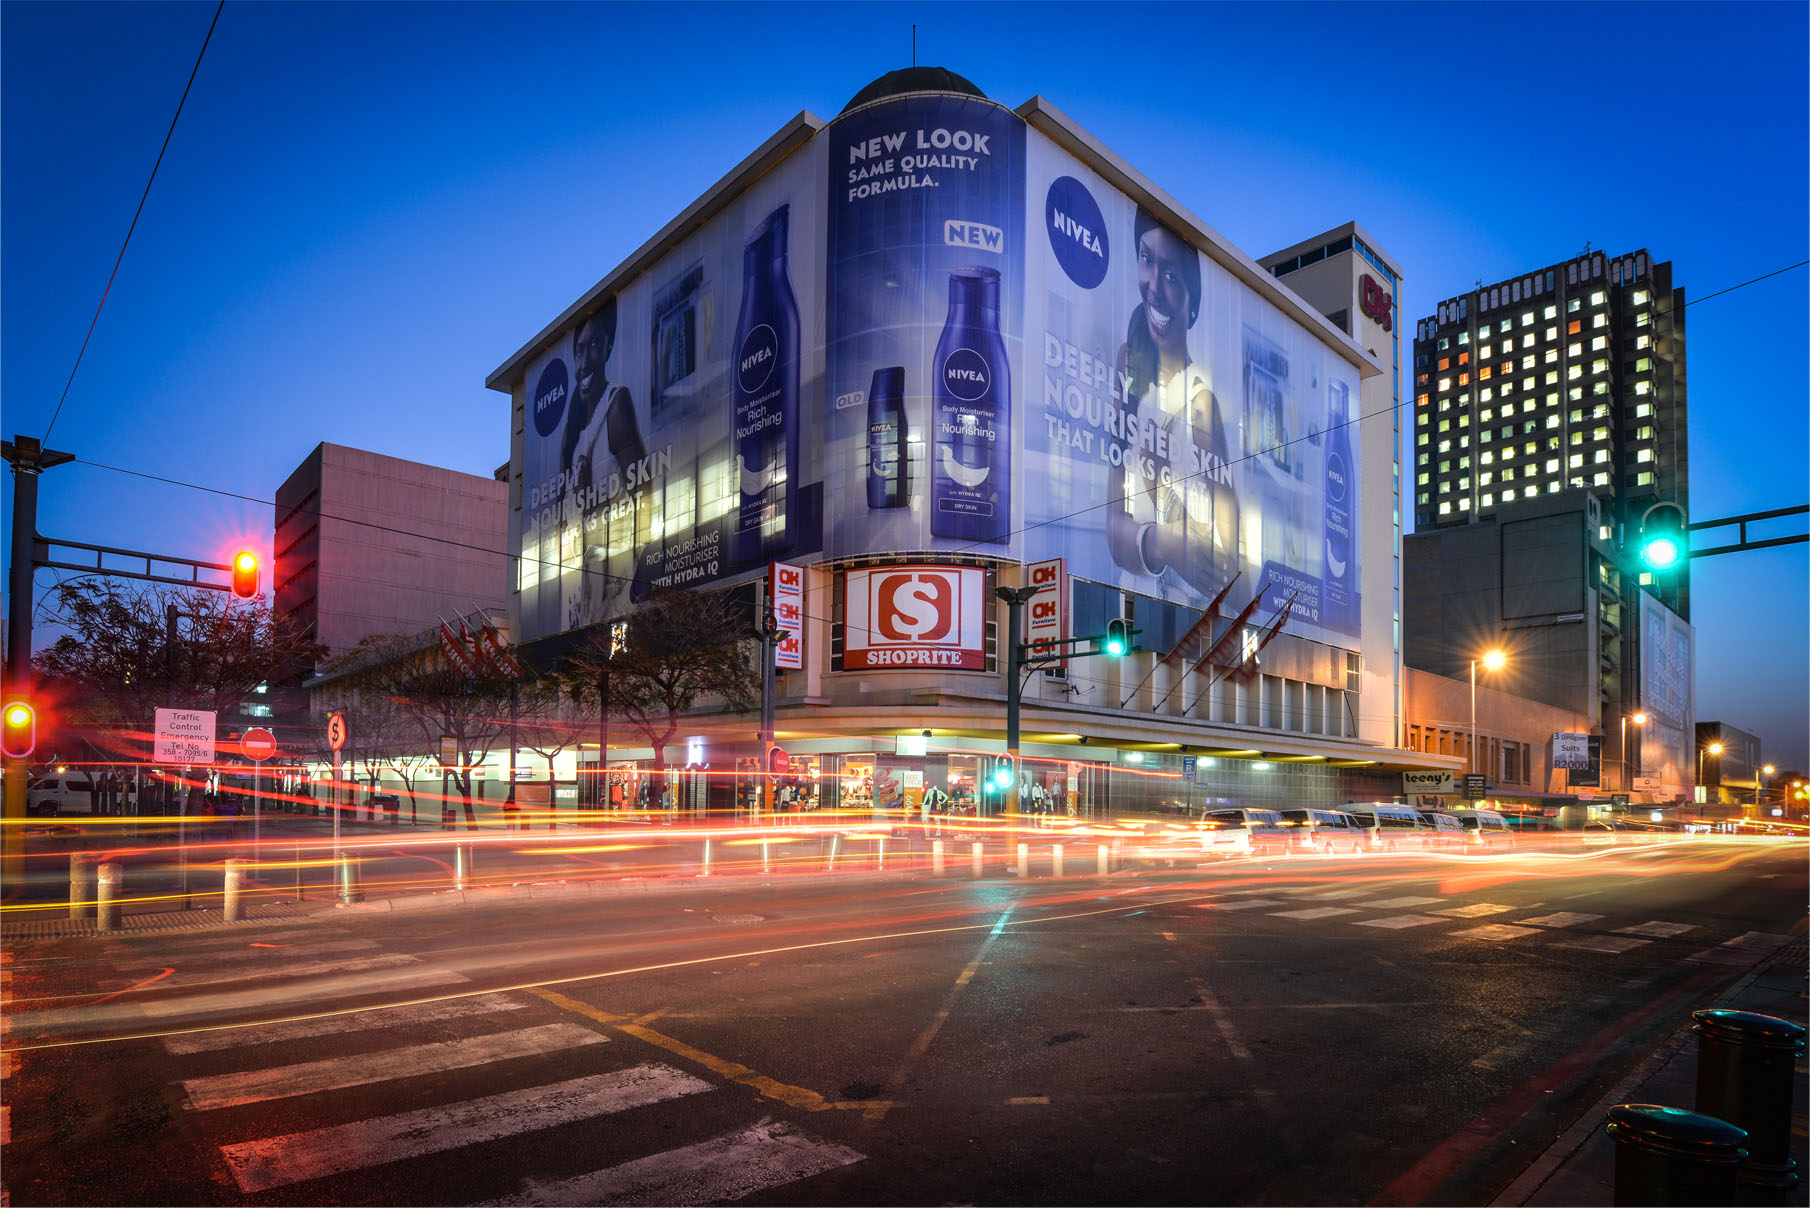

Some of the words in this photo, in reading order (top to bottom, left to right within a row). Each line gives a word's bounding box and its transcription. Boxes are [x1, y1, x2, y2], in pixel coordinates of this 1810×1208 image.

[850, 131, 907, 165] NEW
[917, 128, 991, 155] LOOK
[848, 158, 894, 183] SAME
[901, 154, 979, 173] QUALITY
[848, 173, 940, 202] FORMULA.
[949, 224, 1001, 248] NEW
[1054, 207, 1104, 259] NIVEA
[1359, 273, 1392, 332] OK
[742, 346, 773, 372] NIVEA
[1044, 331, 1134, 404] DEEPLY
[948, 368, 986, 384] NIVEA
[536, 383, 565, 414] NIVEA
[737, 404, 749, 415] Body
[750, 388, 782, 409] Moisturiser
[837, 392, 862, 409] OLD
[747, 405, 767, 422] Rich
[942, 405, 959, 414] Body
[960, 406, 995, 419] Moisturiser
[957, 414, 979, 426] Rich
[736, 411, 782, 440] Nourishing
[871, 424, 892, 433] NIVEA
[942, 423, 995, 440] Nourishing
[1043, 371, 1185, 461] NOURISHED
[1190, 444, 1233, 489] SKIN
[1044, 412, 1095, 454] THAT
[1100, 435, 1156, 481] LOOKS
[531, 461, 583, 510] DEEPLY
[1328, 469, 1344, 486] NIVEA
[530, 471, 621, 534] NOURISHED
[626, 444, 673, 491] SKIN
[601, 490, 645, 526] GREAT.
[646, 553, 664, 566] RICH
[666, 530, 719, 558] NOURISHING
[664, 545, 719, 573] MOISTURISER
[674, 565, 705, 585] HYDRA
[708, 561, 719, 575] IQ
[779, 568, 799, 586] OK
[1032, 565, 1056, 584] OK
[779, 584, 799, 592] Furniture
[1268, 569, 1282, 583] RICH
[1284, 575, 1319, 596] NOURISHING
[779, 603, 799, 620] OK
[1032, 601, 1056, 619] OK
[1290, 602, 1311, 618] HYDRA
[1311, 609, 1319, 622] IQ
[779, 619, 799, 627] Furniture
[779, 637, 799, 653] OK
[778, 651, 799, 659] Furniture
[866, 650, 962, 665] SHOPRITE
[172, 712, 200, 721] Traffic
[170, 722, 202, 731] Control
[332, 723, 340, 742] S
[160, 731, 209, 743] Emergency
[171, 742, 184, 750] Tel
[1554, 732, 1560, 740] 3
[1560, 734, 1587, 742] Designer
[162, 748, 176, 756] 358
[1561, 744, 1580, 752] Suits
[1554, 760, 1588, 769] R2000
[1405, 772, 1451, 785] teeny's
